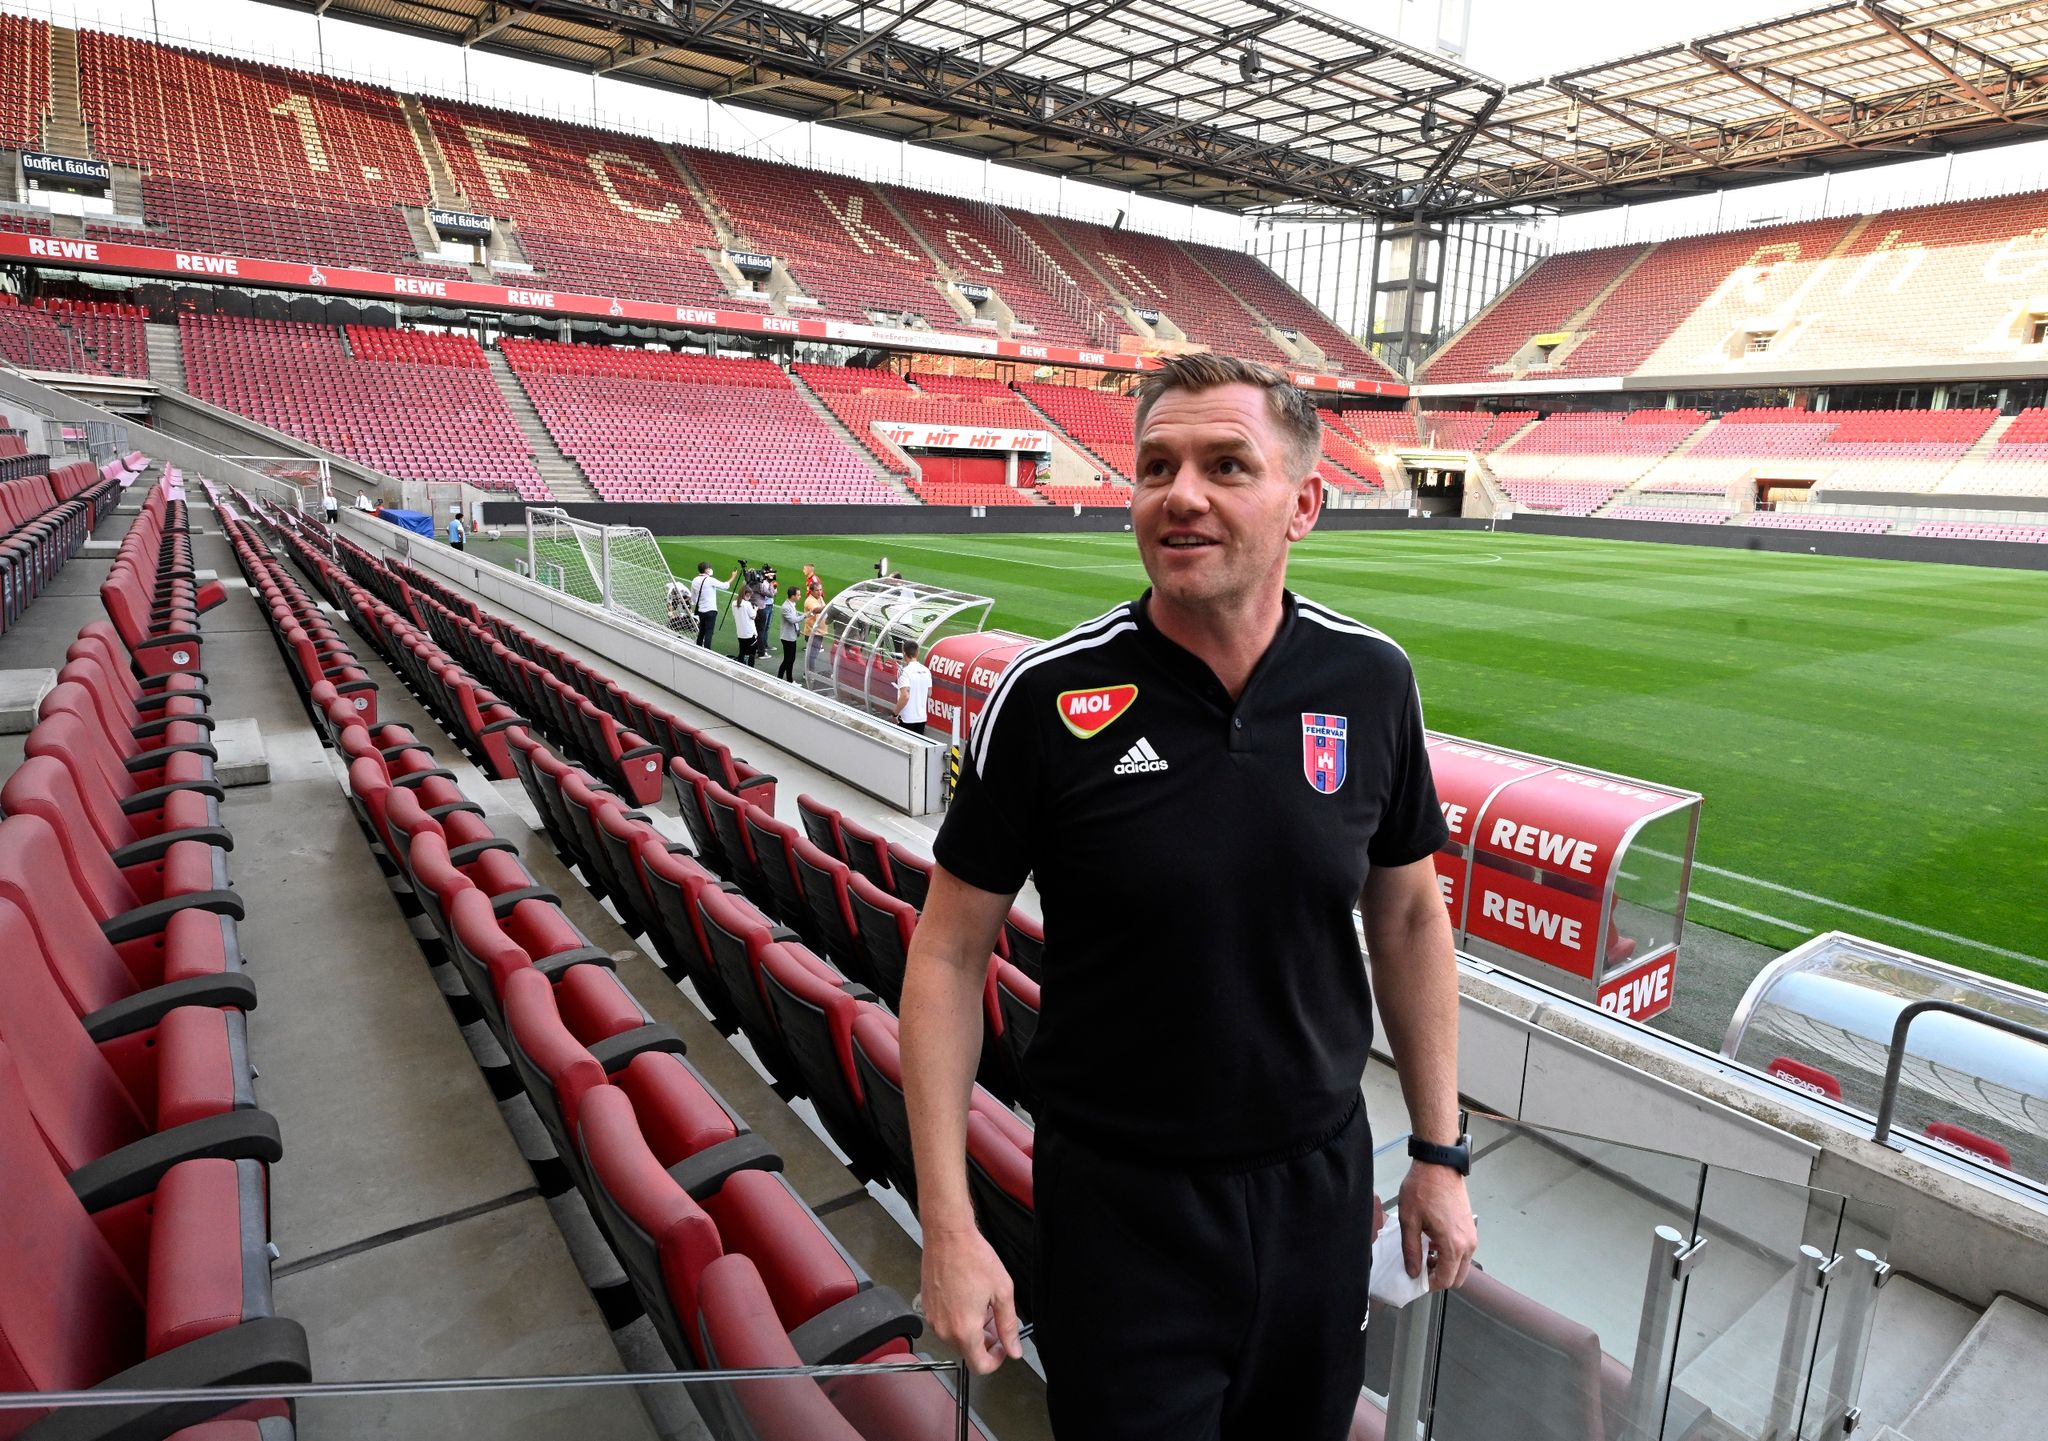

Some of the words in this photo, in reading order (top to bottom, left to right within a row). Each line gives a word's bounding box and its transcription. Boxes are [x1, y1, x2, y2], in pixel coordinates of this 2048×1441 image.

[29, 238, 99, 260] REWE
[176, 254, 238, 275] REWE
[394, 278, 446, 296] REWE
[508, 290, 555, 307] REWE
[677, 307, 717, 323] REWE
[763, 317, 799, 332] REWE
[1020, 345, 1048, 358] REWE
[1079, 352, 1105, 364] REWE
[1296, 375, 1315, 386] REWE
[1337, 380, 1356, 390] REWE
[925, 432, 959, 446] HIT
[969, 435, 1002, 448] HIT
[1011, 436, 1042, 449] HIT
[929, 654, 965, 679] REWE
[971, 666, 1000, 688] REW
[1069, 694, 1111, 715] MOL
[1114, 760, 1169, 774] adidas
[1553, 772, 1665, 804] REWE
[1490, 817, 1597, 874] REWE
[1482, 889, 1582, 950] REWE
[1776, 1069, 1825, 1096] RECARO
